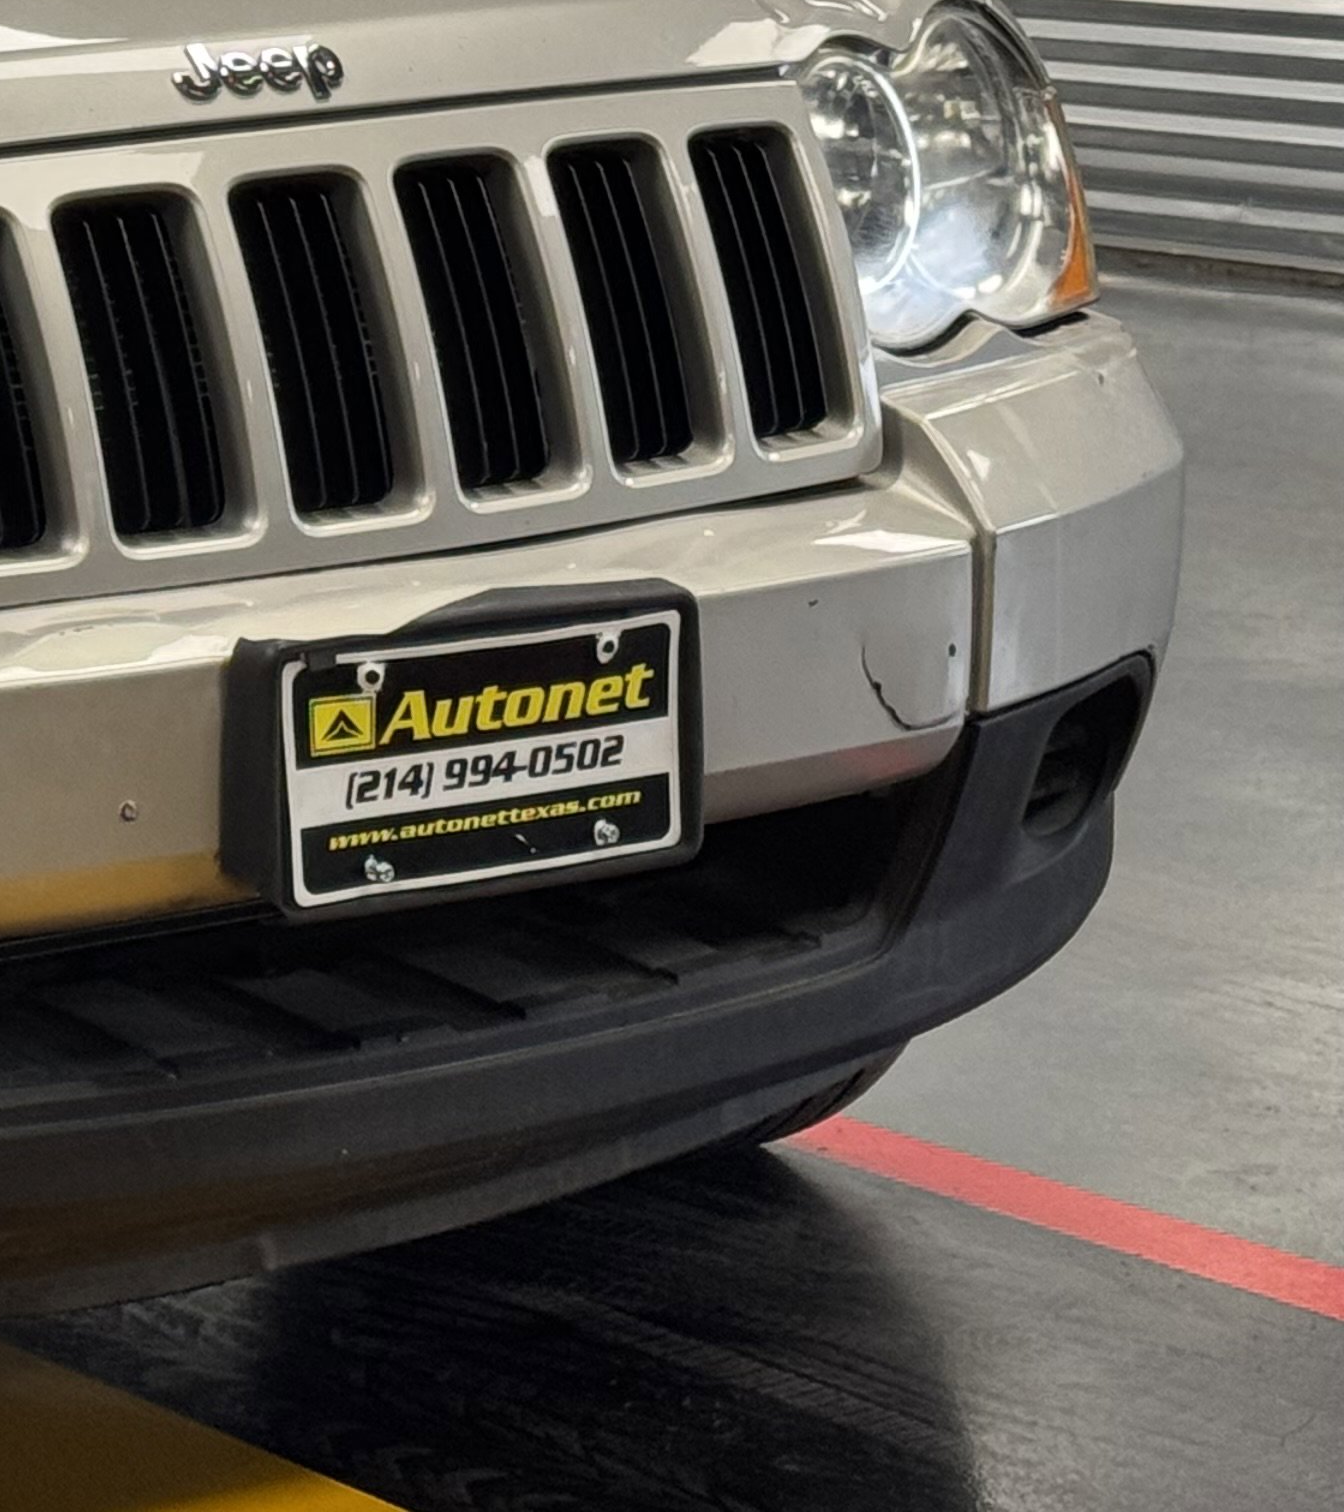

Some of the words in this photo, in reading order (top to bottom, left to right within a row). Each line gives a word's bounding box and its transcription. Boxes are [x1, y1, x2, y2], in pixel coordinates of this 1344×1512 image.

[171, 43, 344, 101] Jeep
[379, 663, 654, 745] Autonet
[346, 761, 435, 810] (214)
[443, 735, 624, 791] 994-0502
[328, 790, 641, 851] www.autonettexas.com
